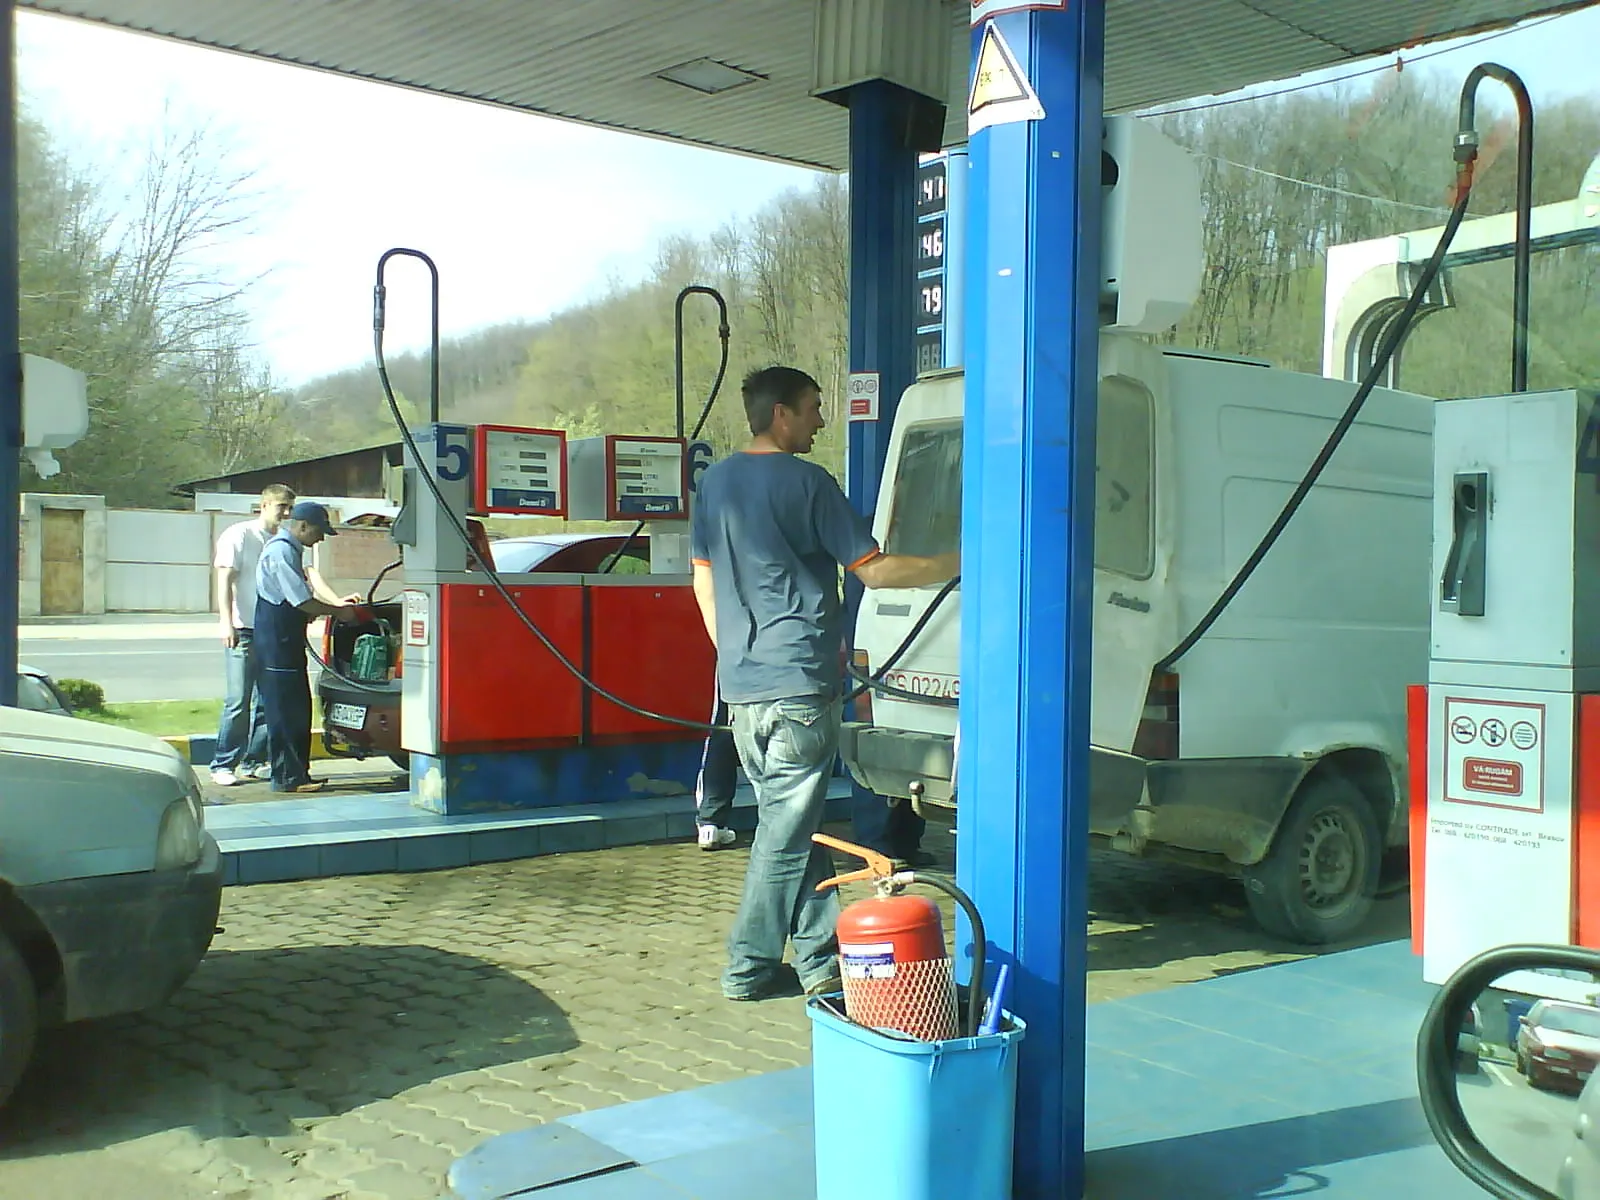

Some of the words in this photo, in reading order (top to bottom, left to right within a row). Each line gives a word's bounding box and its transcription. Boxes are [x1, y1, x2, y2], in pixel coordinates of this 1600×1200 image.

[922, 229, 943, 257] 46
[921, 285, 942, 314] 79
[436, 424, 470, 481] 5
[687, 442, 713, 492] 6
